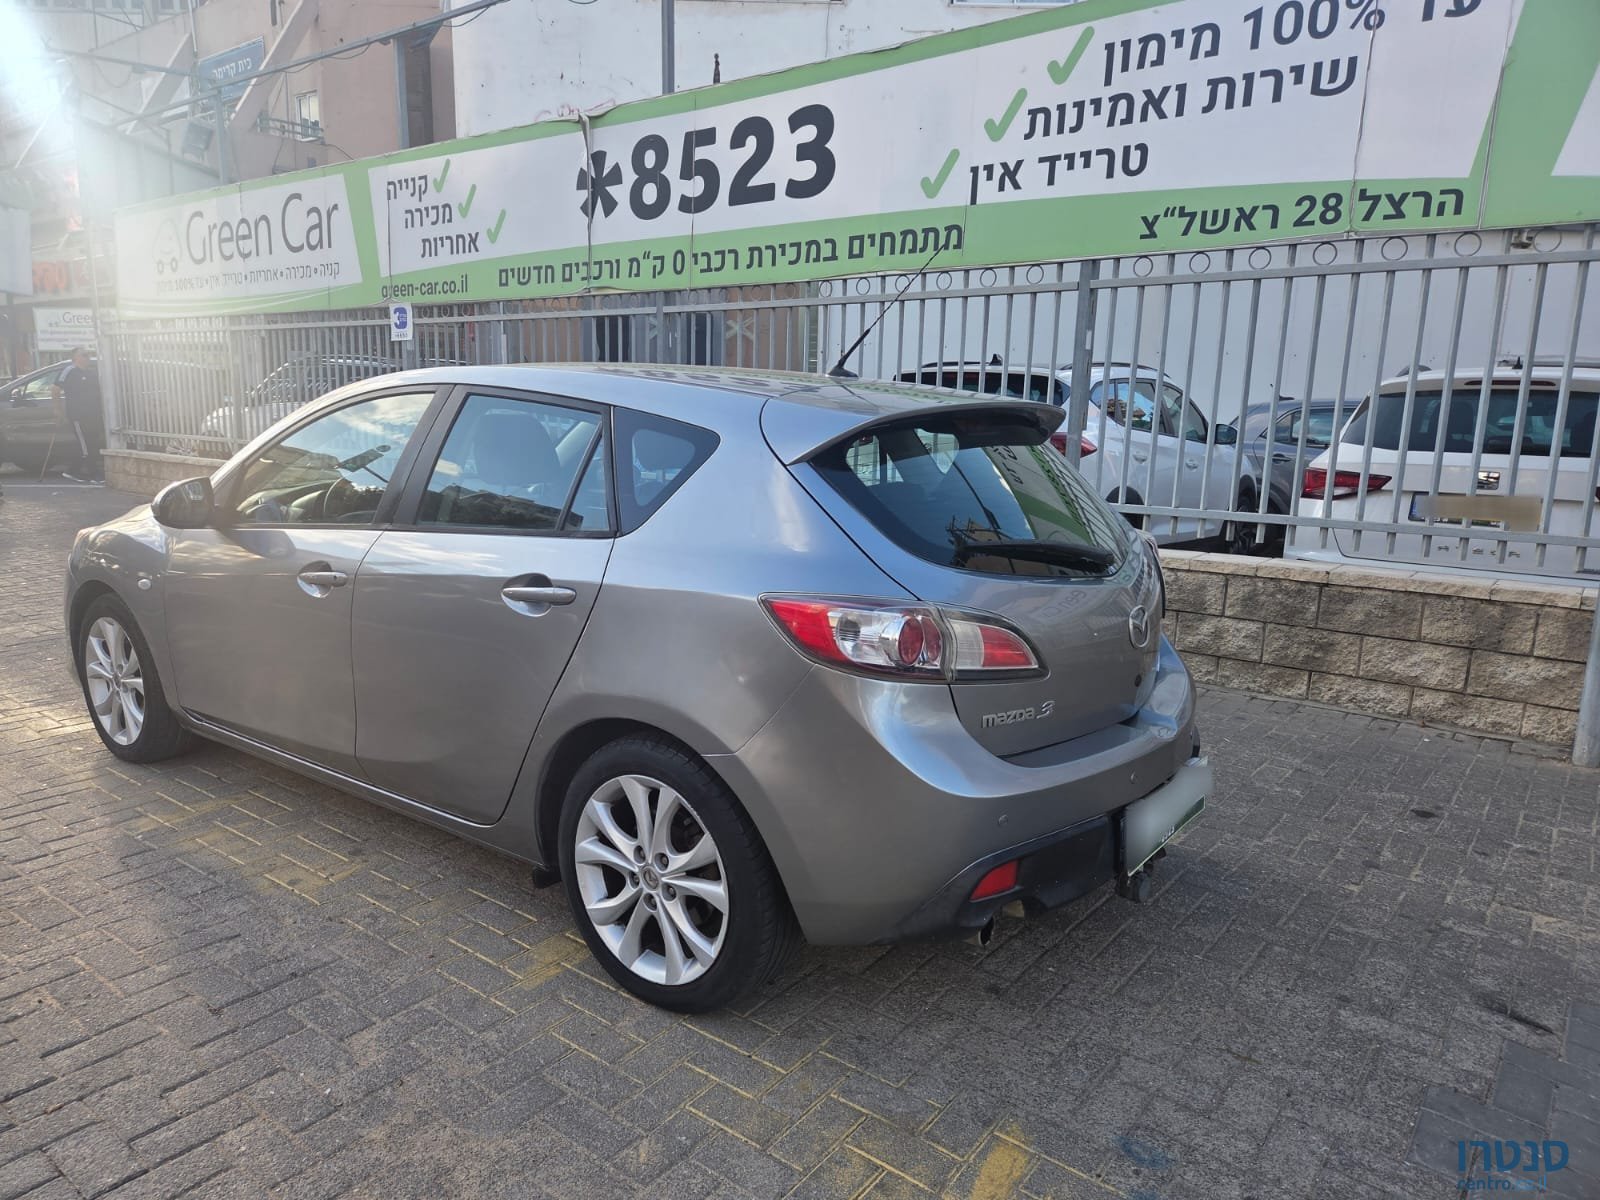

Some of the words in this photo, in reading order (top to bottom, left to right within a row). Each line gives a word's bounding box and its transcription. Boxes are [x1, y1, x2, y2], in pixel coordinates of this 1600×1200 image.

[1243, 0, 1386, 50] 100%
[1103, 22, 1221, 87] מימון
[1201, 55, 1358, 114] שירות
[1023, 83, 1187, 140] ואמינות
[1037, 142, 1149, 187] טרייד
[386, 175, 428, 203] קנייה
[970, 159, 1025, 206] אין
[404, 203, 453, 229] מכירה
[1293, 192, 1343, 228] 28
[1358, 188, 1464, 222] הרצל
[186, 210, 273, 265] Green
[281, 192, 339, 253] Car
[847, 223, 963, 260] מתמחים
[421, 232, 480, 258] אחריות
[746, 237, 839, 270] במכירת
[249, 268, 279, 284] אחריות
[285, 265, 312, 280] מכירה
[319, 262, 340, 280] קניה
[498, 264, 555, 288] חדשים
[561, 258, 621, 283] ורכבים
[672, 249, 686, 276] 0
[691, 248, 739, 274] רכבי
[62, 311, 91, 324] Gree
